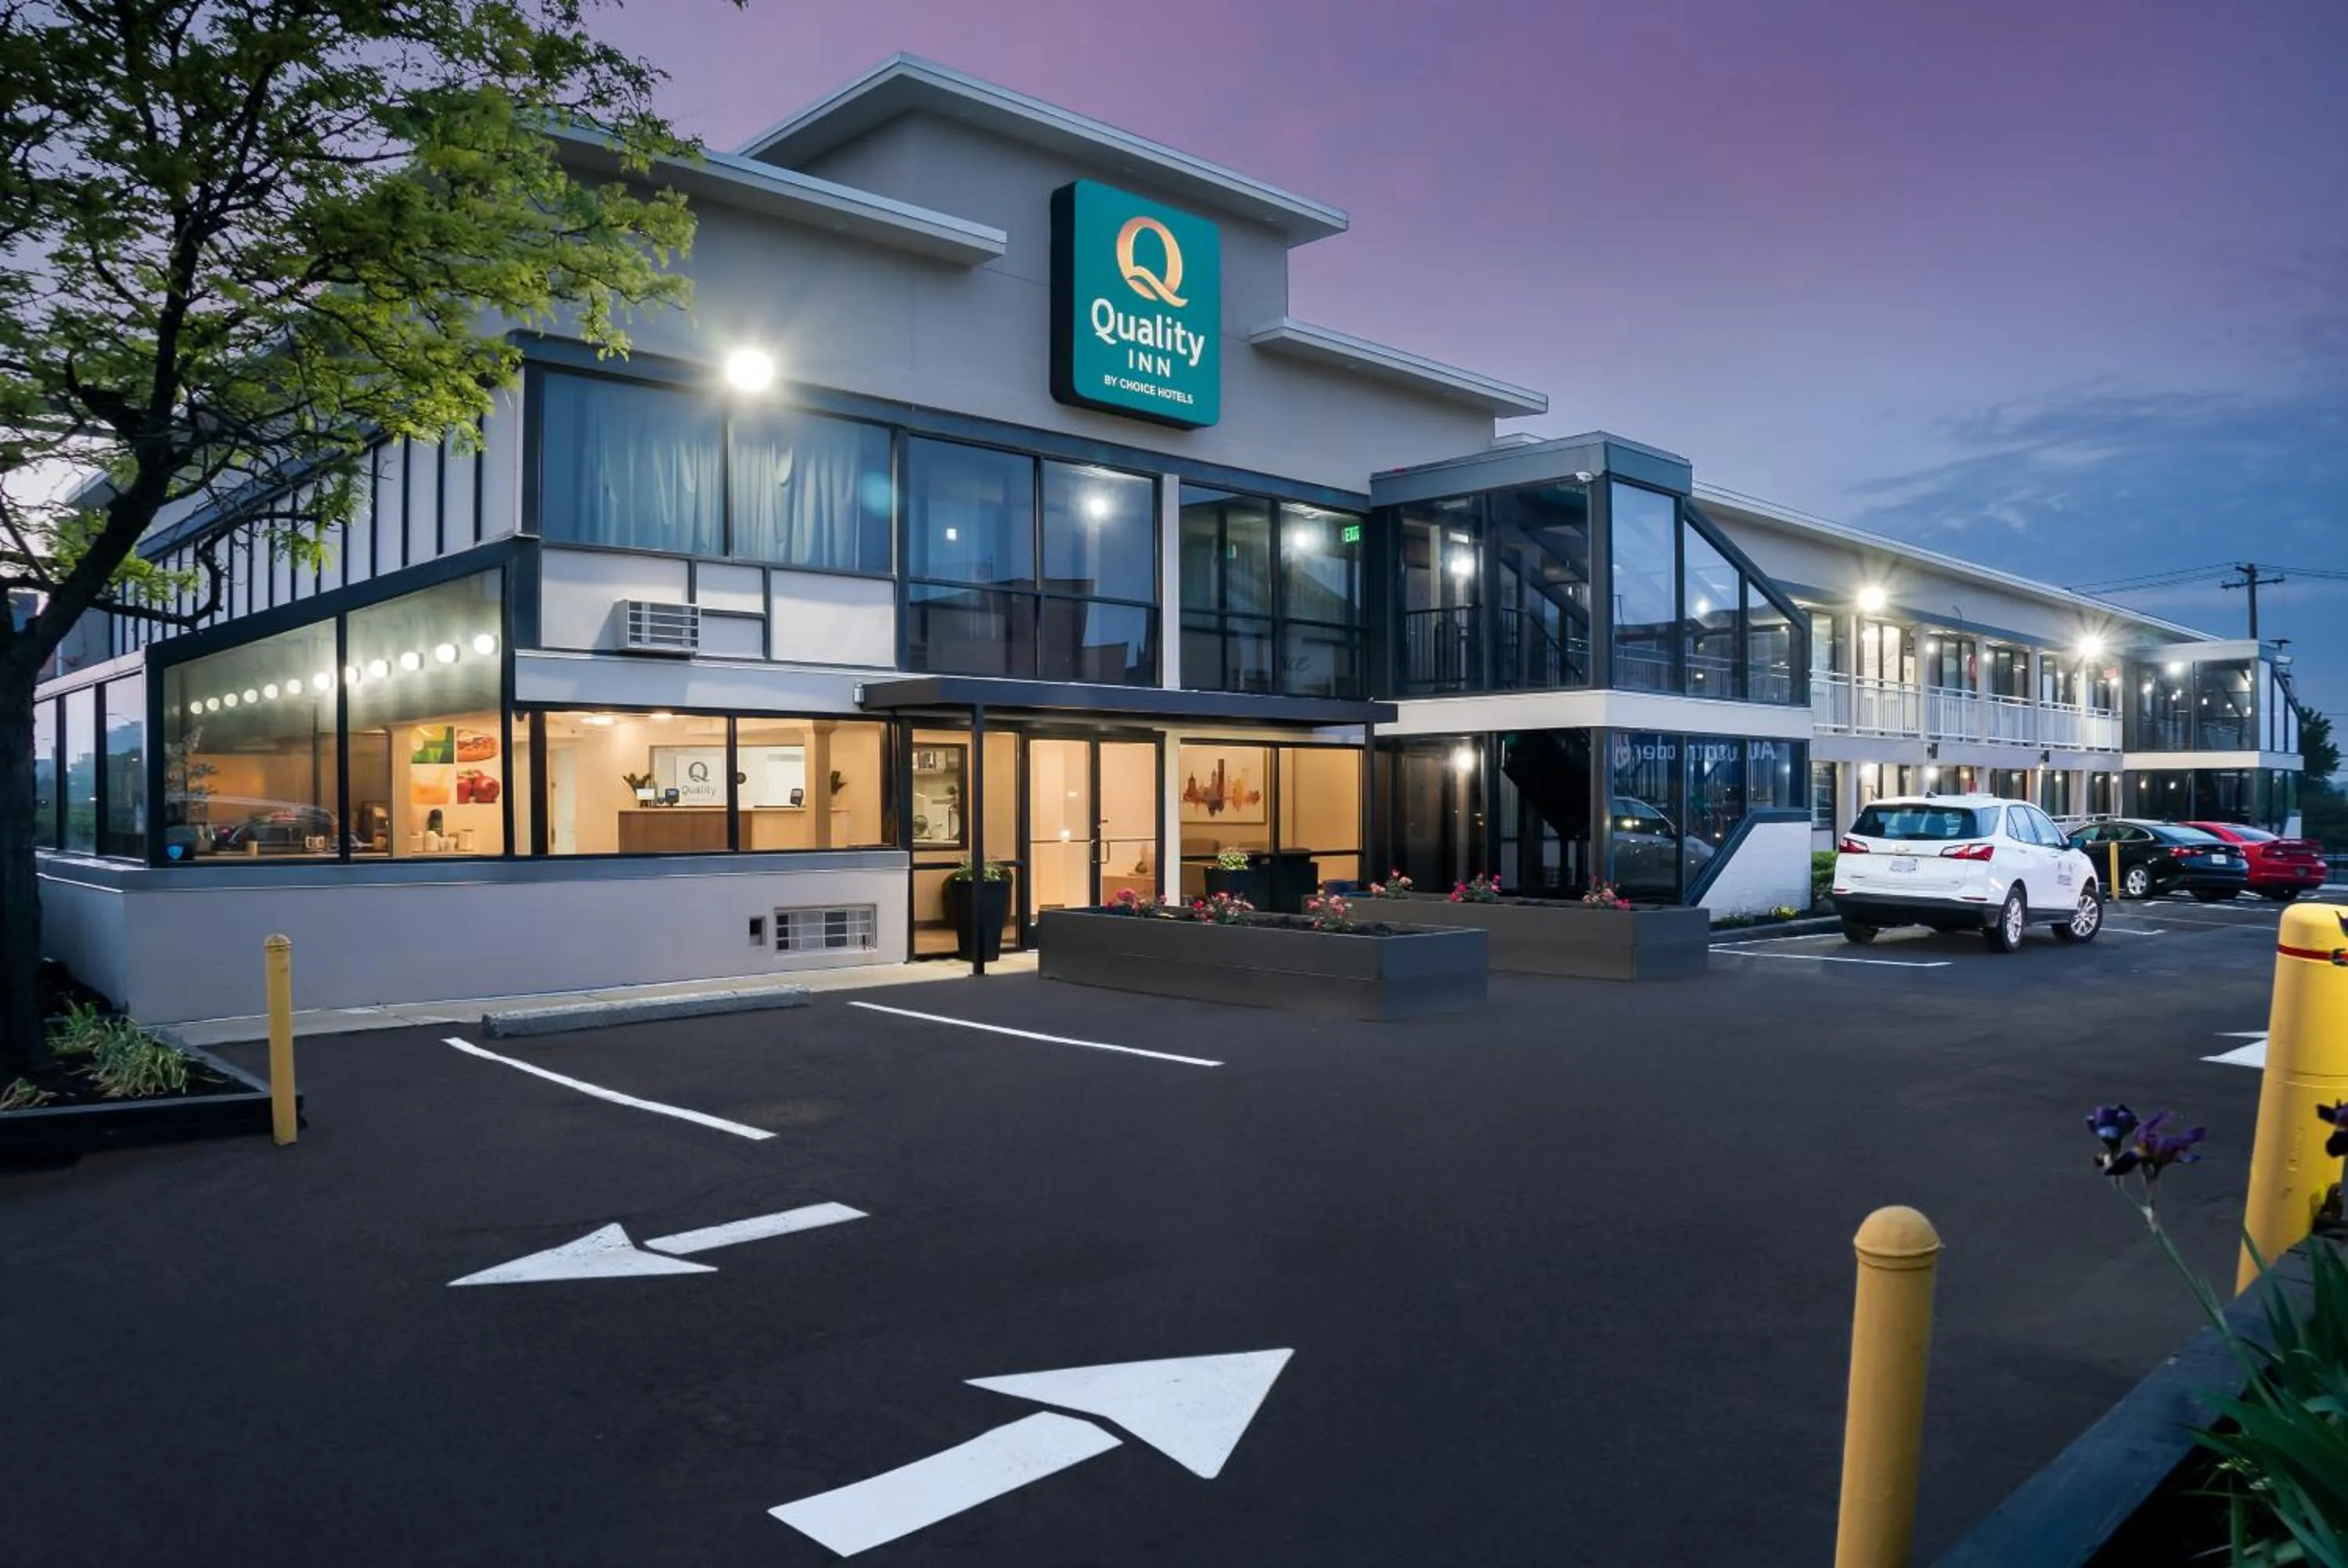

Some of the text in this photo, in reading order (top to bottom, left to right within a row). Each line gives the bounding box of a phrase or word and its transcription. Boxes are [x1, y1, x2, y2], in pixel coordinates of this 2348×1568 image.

[1116, 216, 1188, 307] Q
[1091, 298, 1205, 367] Quality
[1128, 349, 1171, 378] INN
[1104, 375, 1194, 405] BY CHOICE HOTELS
[682, 785, 715, 797] Quality
